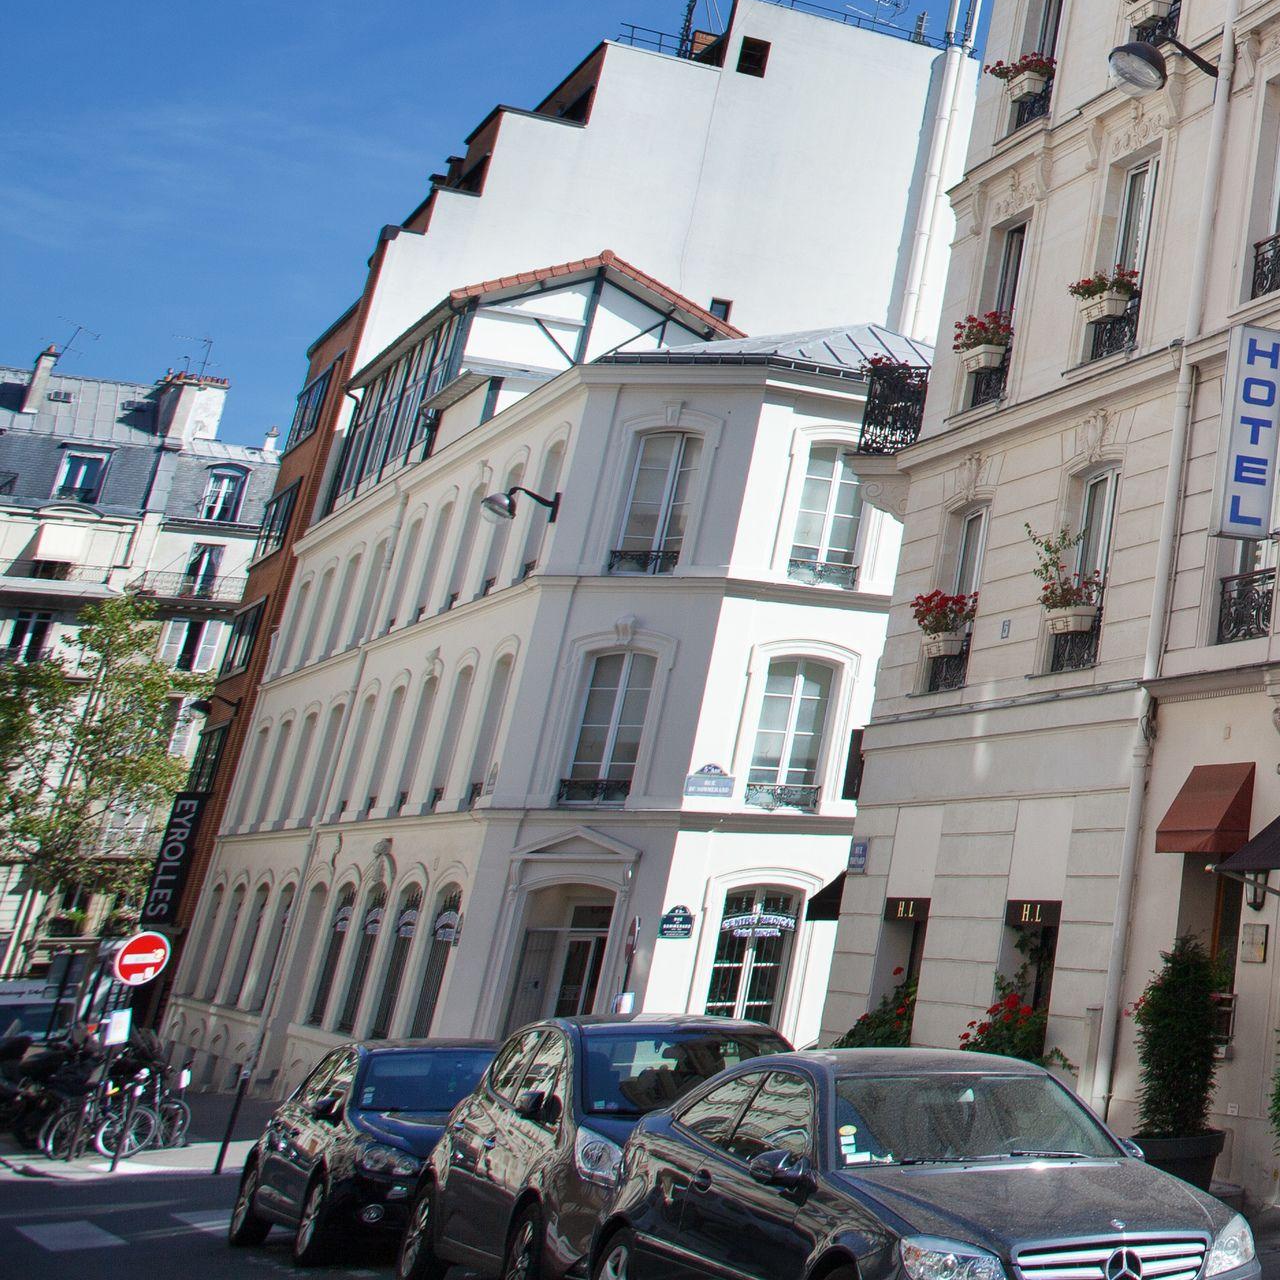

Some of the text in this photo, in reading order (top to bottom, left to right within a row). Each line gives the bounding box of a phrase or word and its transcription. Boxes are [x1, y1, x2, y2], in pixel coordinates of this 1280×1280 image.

[1229, 338, 1280, 526] HOTEL
[146, 799, 199, 916] EYROLLES
[722, 914, 758, 929] CENTRE
[1021, 903, 1042, 922] H.L
